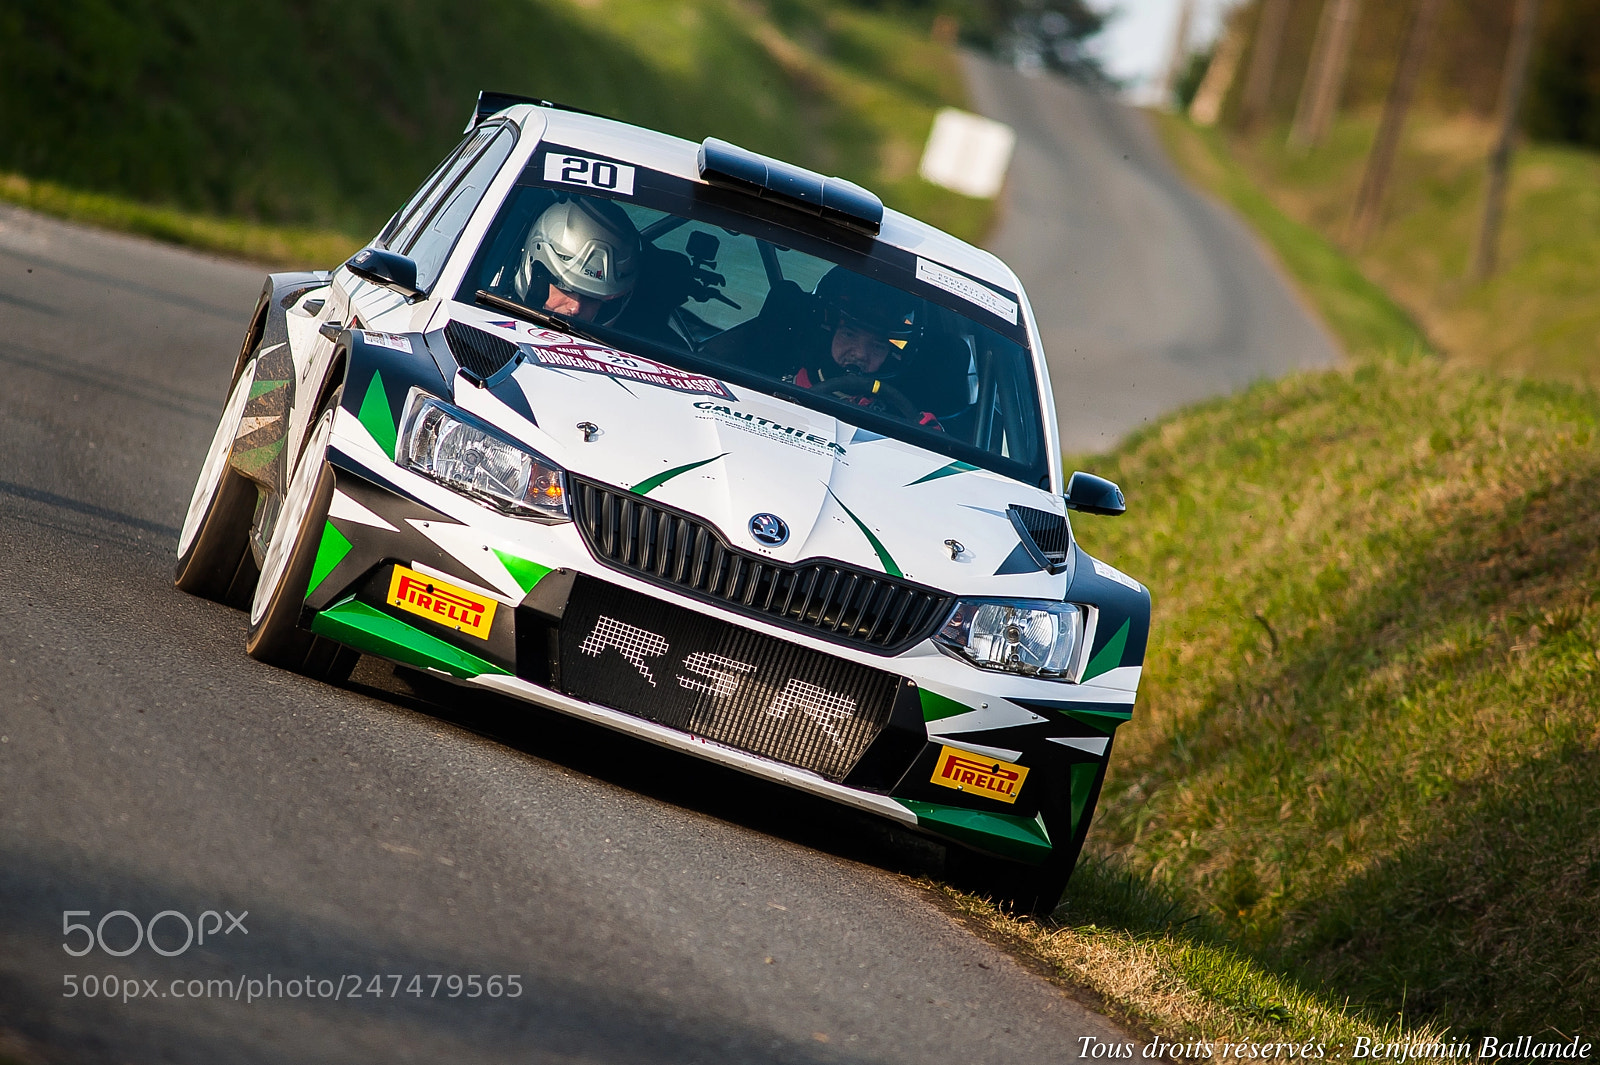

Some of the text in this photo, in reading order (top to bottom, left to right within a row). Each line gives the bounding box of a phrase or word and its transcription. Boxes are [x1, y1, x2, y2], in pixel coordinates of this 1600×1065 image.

[561, 157, 618, 189] 20
[531, 346, 724, 396] BORDEAUX AQUITAINE CLASSIC
[608, 355, 639, 368] 20
[693, 402, 847, 456] GAUTHIER
[396, 575, 485, 628] PIRELLI
[941, 755, 1019, 794] PIRELLI
